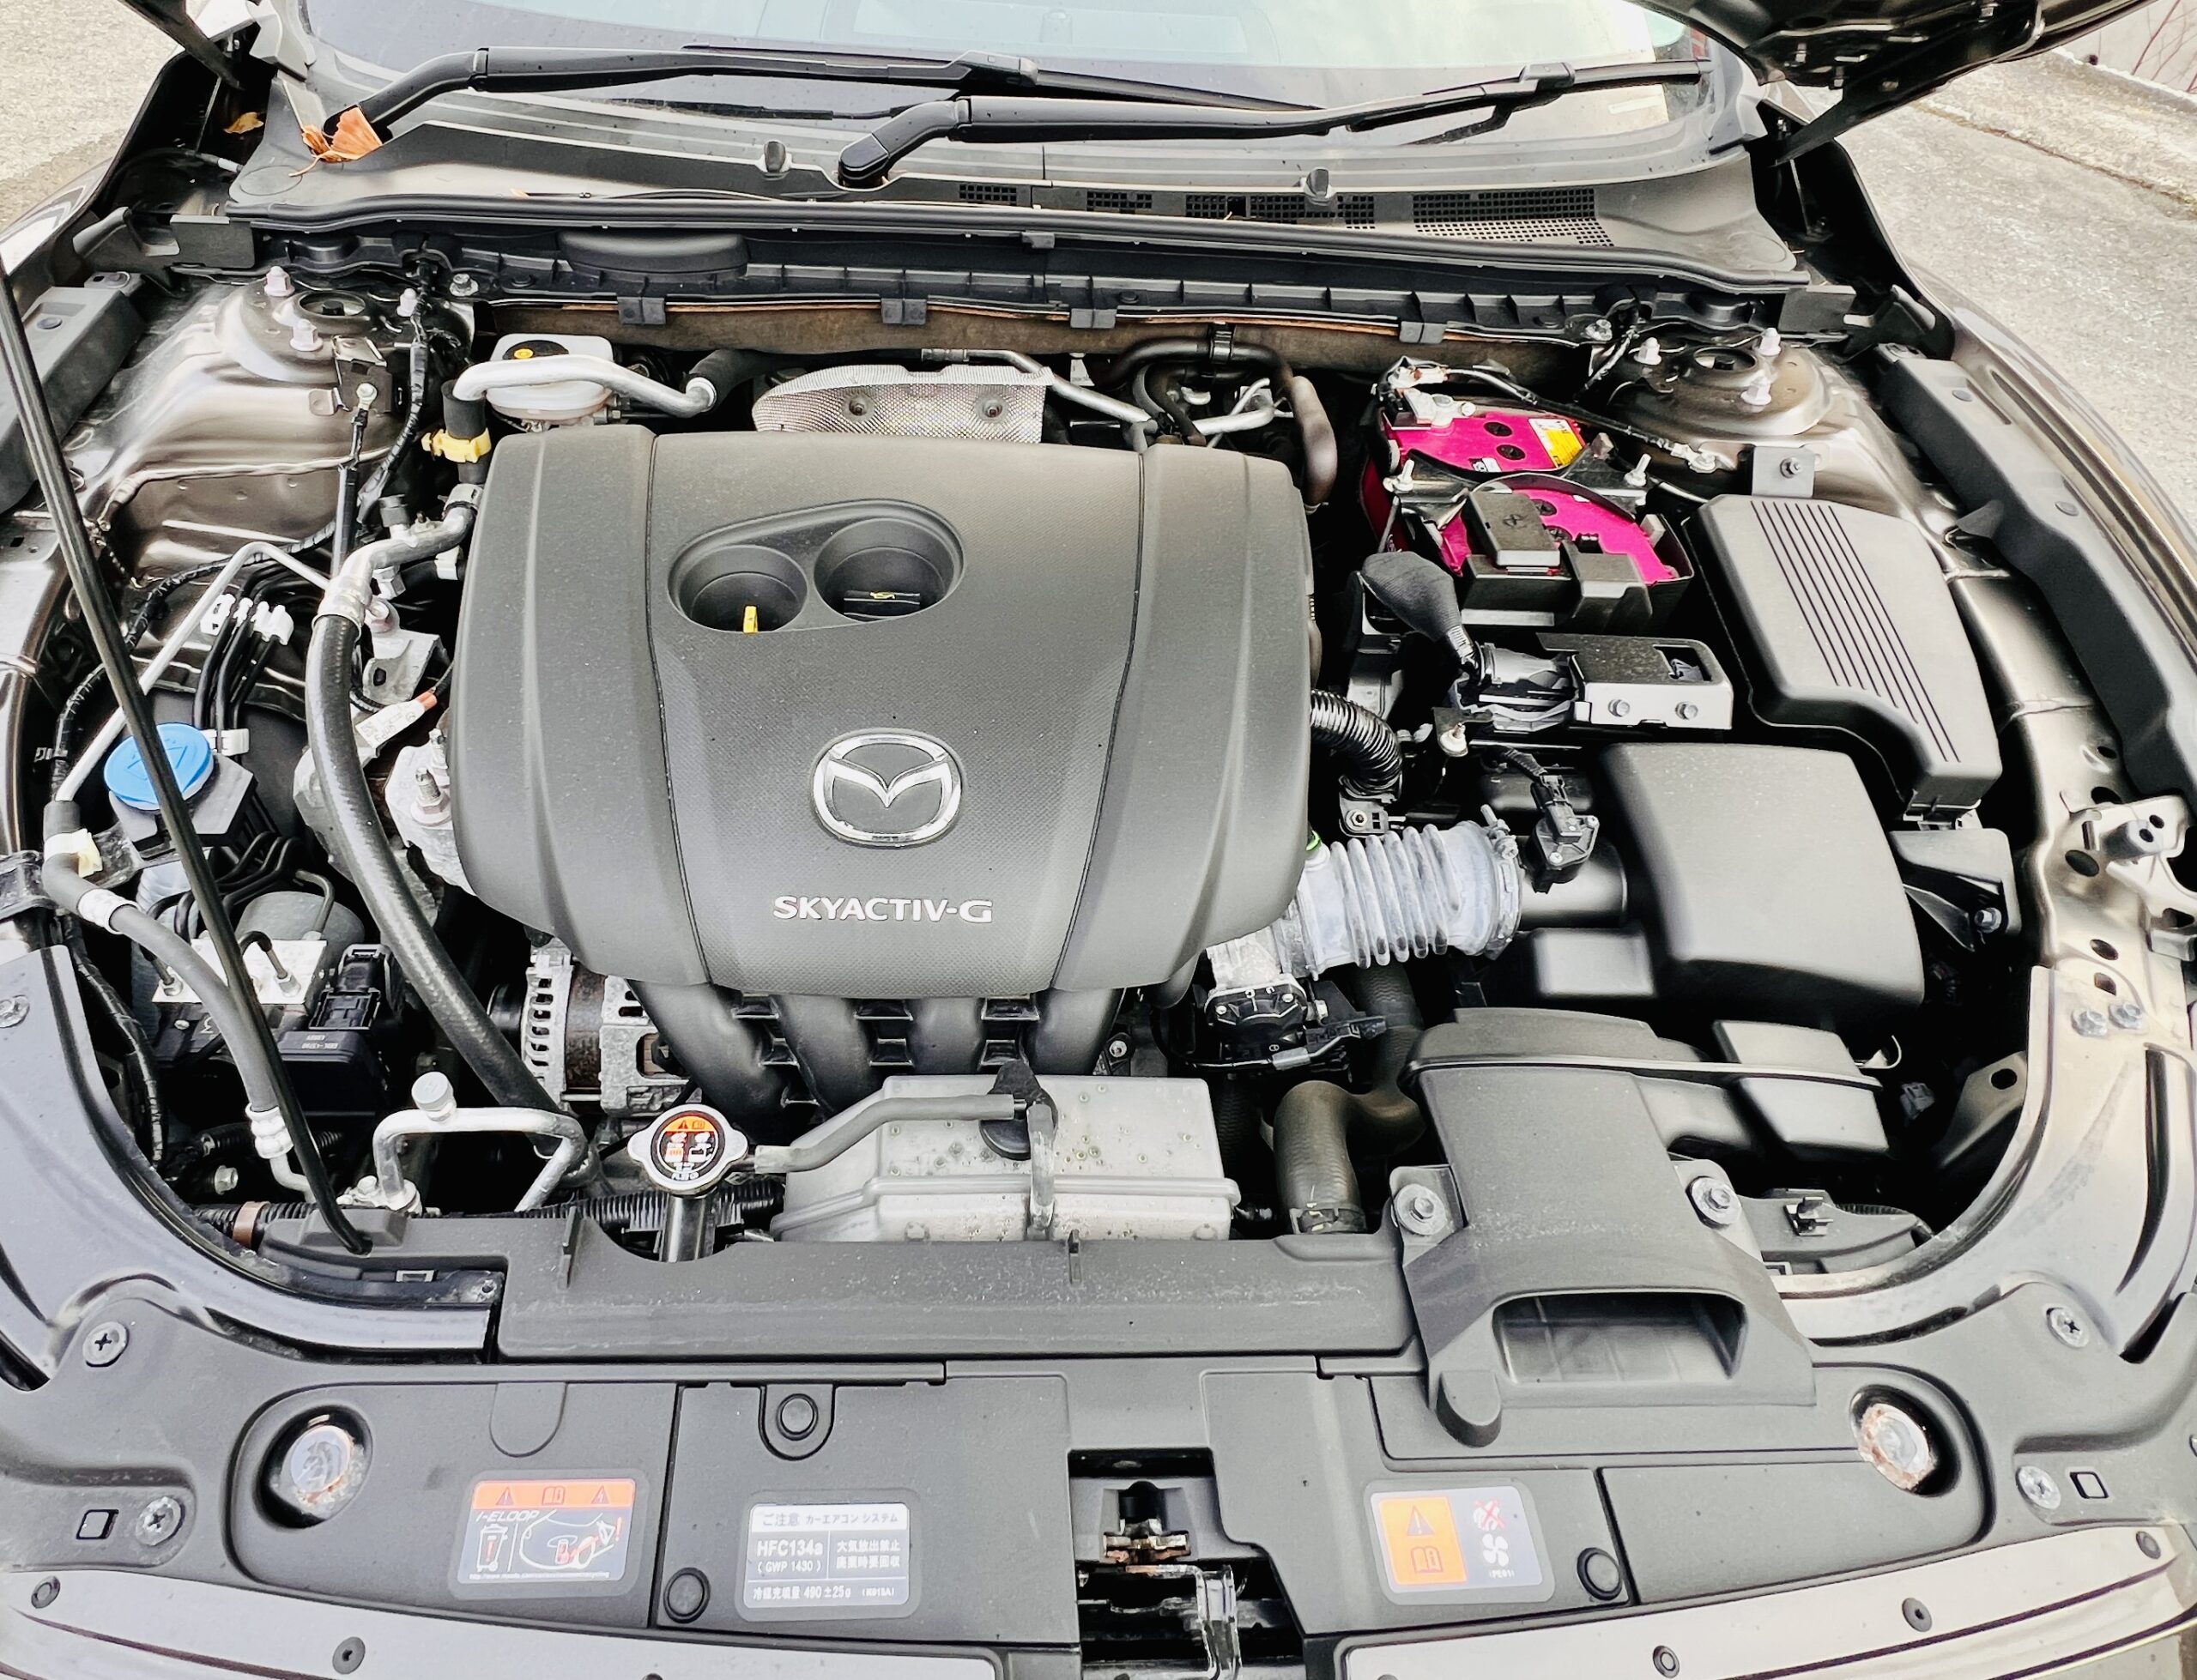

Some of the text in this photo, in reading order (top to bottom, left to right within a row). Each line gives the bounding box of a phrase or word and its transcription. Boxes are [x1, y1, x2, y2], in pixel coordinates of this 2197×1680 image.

[773, 896, 992, 923] SKYACTIV-G
[763, 1513, 800, 1526] ご注意
[757, 1539, 824, 1557] HFC134a
